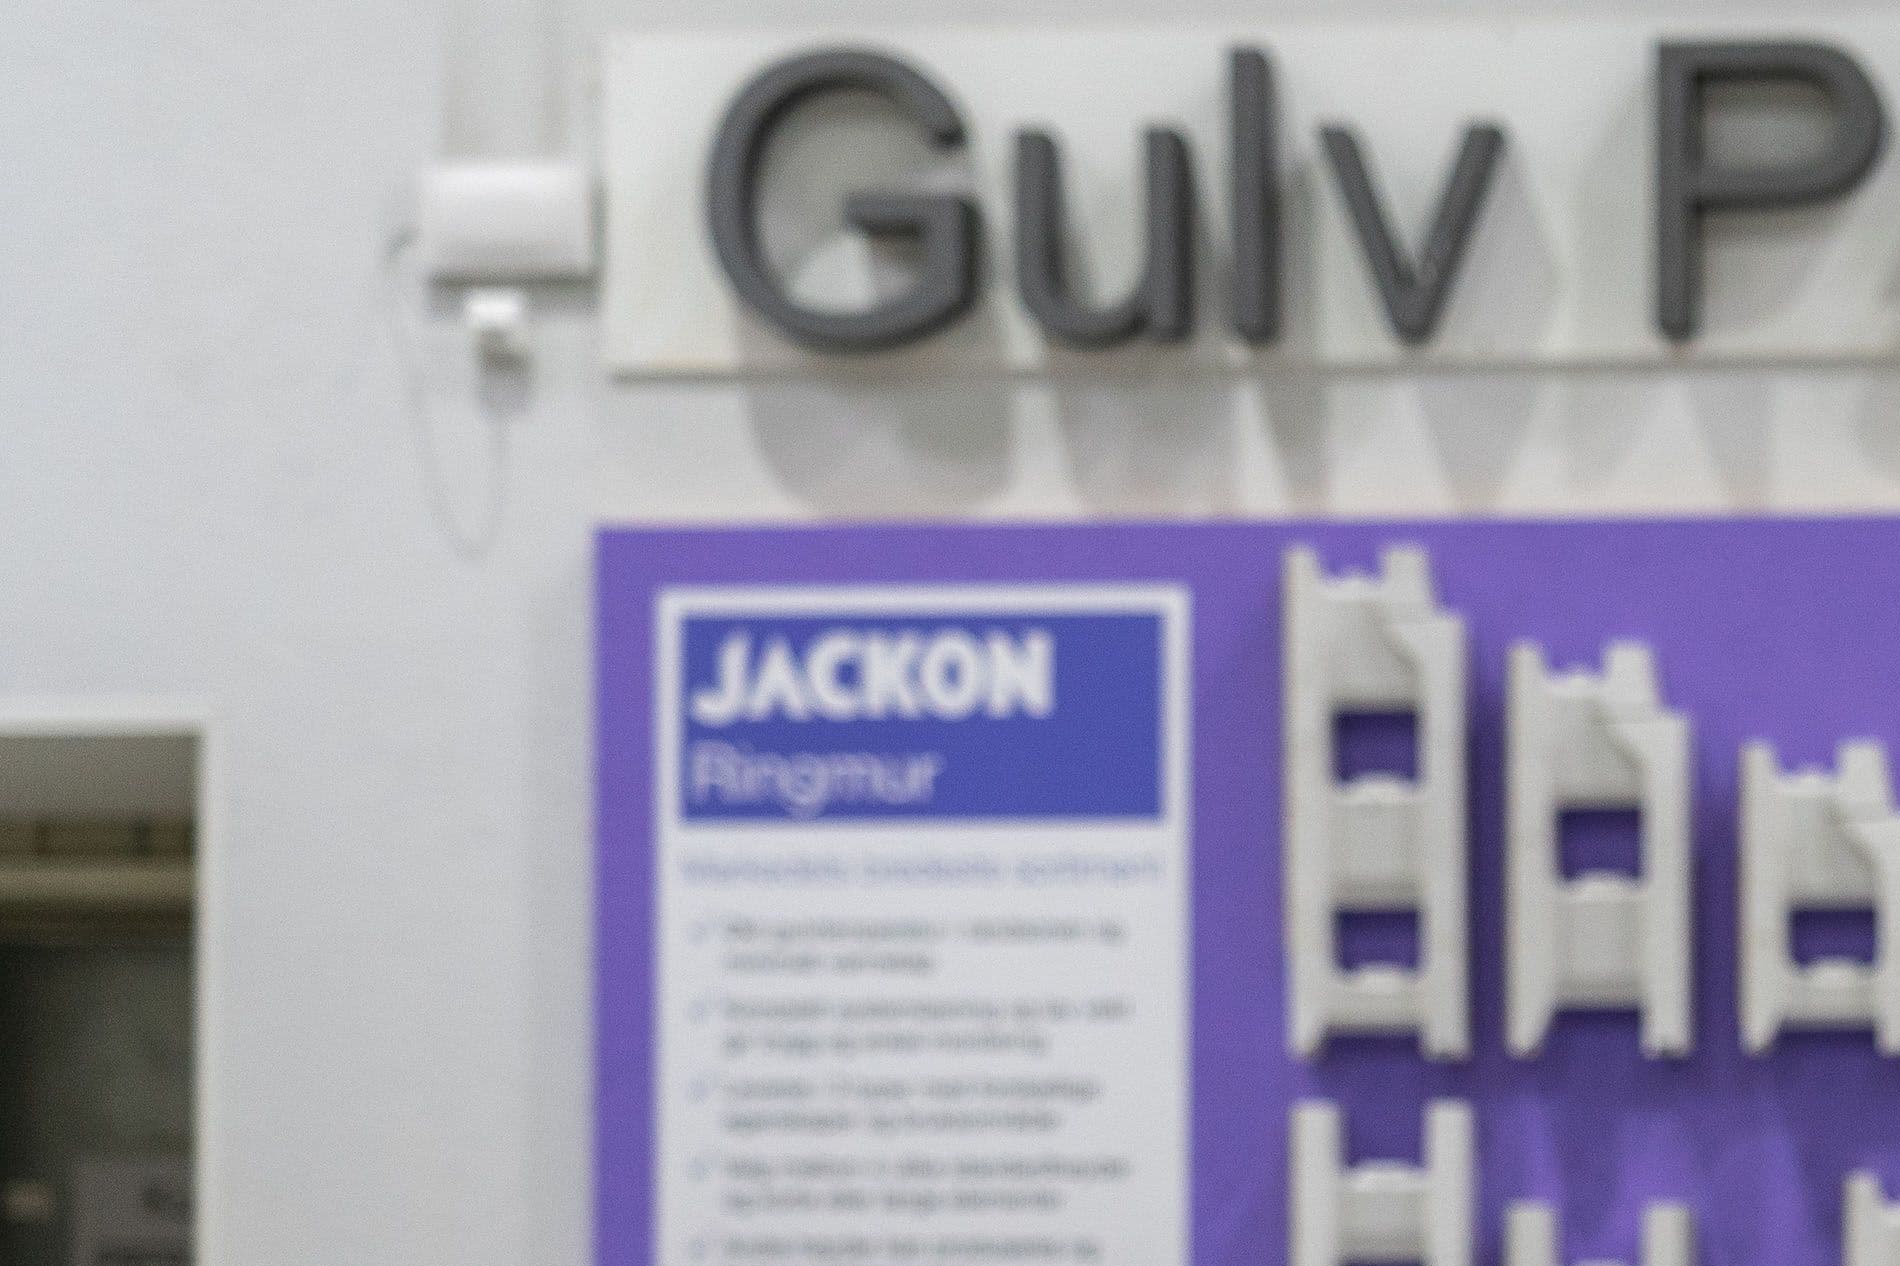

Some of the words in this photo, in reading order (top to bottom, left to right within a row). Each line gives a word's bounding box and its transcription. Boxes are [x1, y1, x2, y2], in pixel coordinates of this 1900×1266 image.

[704, 42, 1508, 352] Gulv
[693, 628, 1055, 725] JACKON
[690, 740, 944, 819] Ringmur
